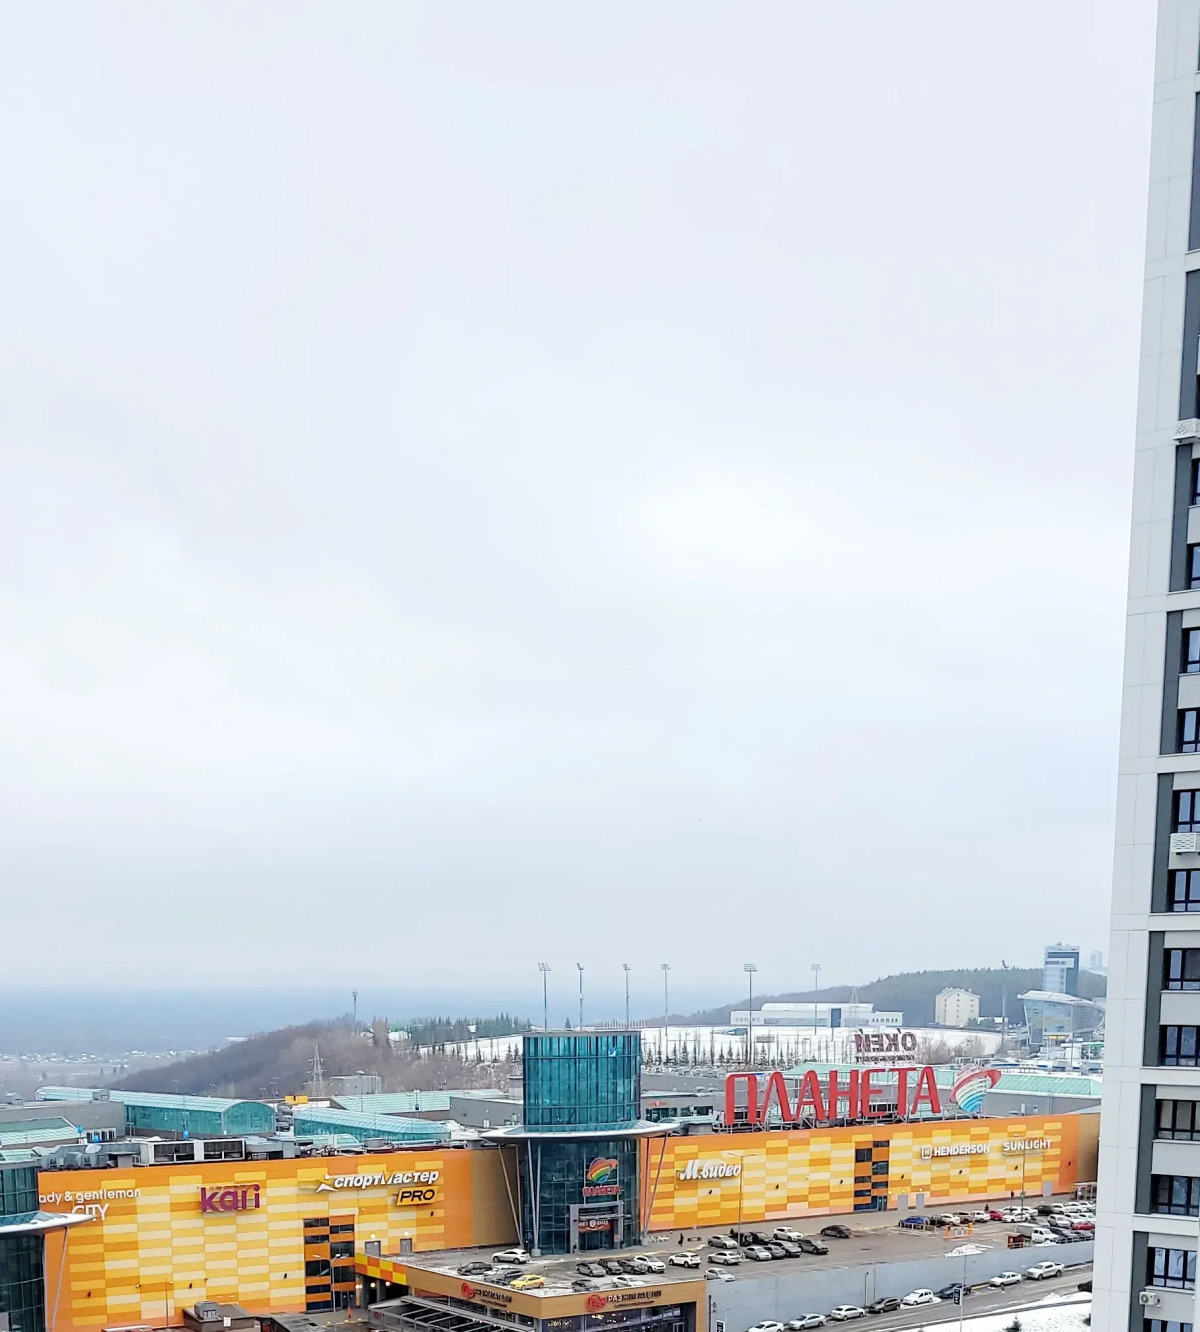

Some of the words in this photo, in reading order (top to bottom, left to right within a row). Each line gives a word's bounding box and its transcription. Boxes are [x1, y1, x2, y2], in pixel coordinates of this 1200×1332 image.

[725, 1066, 942, 1126] ПЛАНЕТА
[934, 1143, 990, 1157] HENDERSON
[1003, 1138, 1052, 1151] SUNLIGHT
[39, 1192, 62, 1205] ady
[64, 1191, 74, 1202] &
[76, 1188, 141, 1203] gentleman
[201, 1183, 260, 1212] kari
[399, 1189, 435, 1203] PRO
